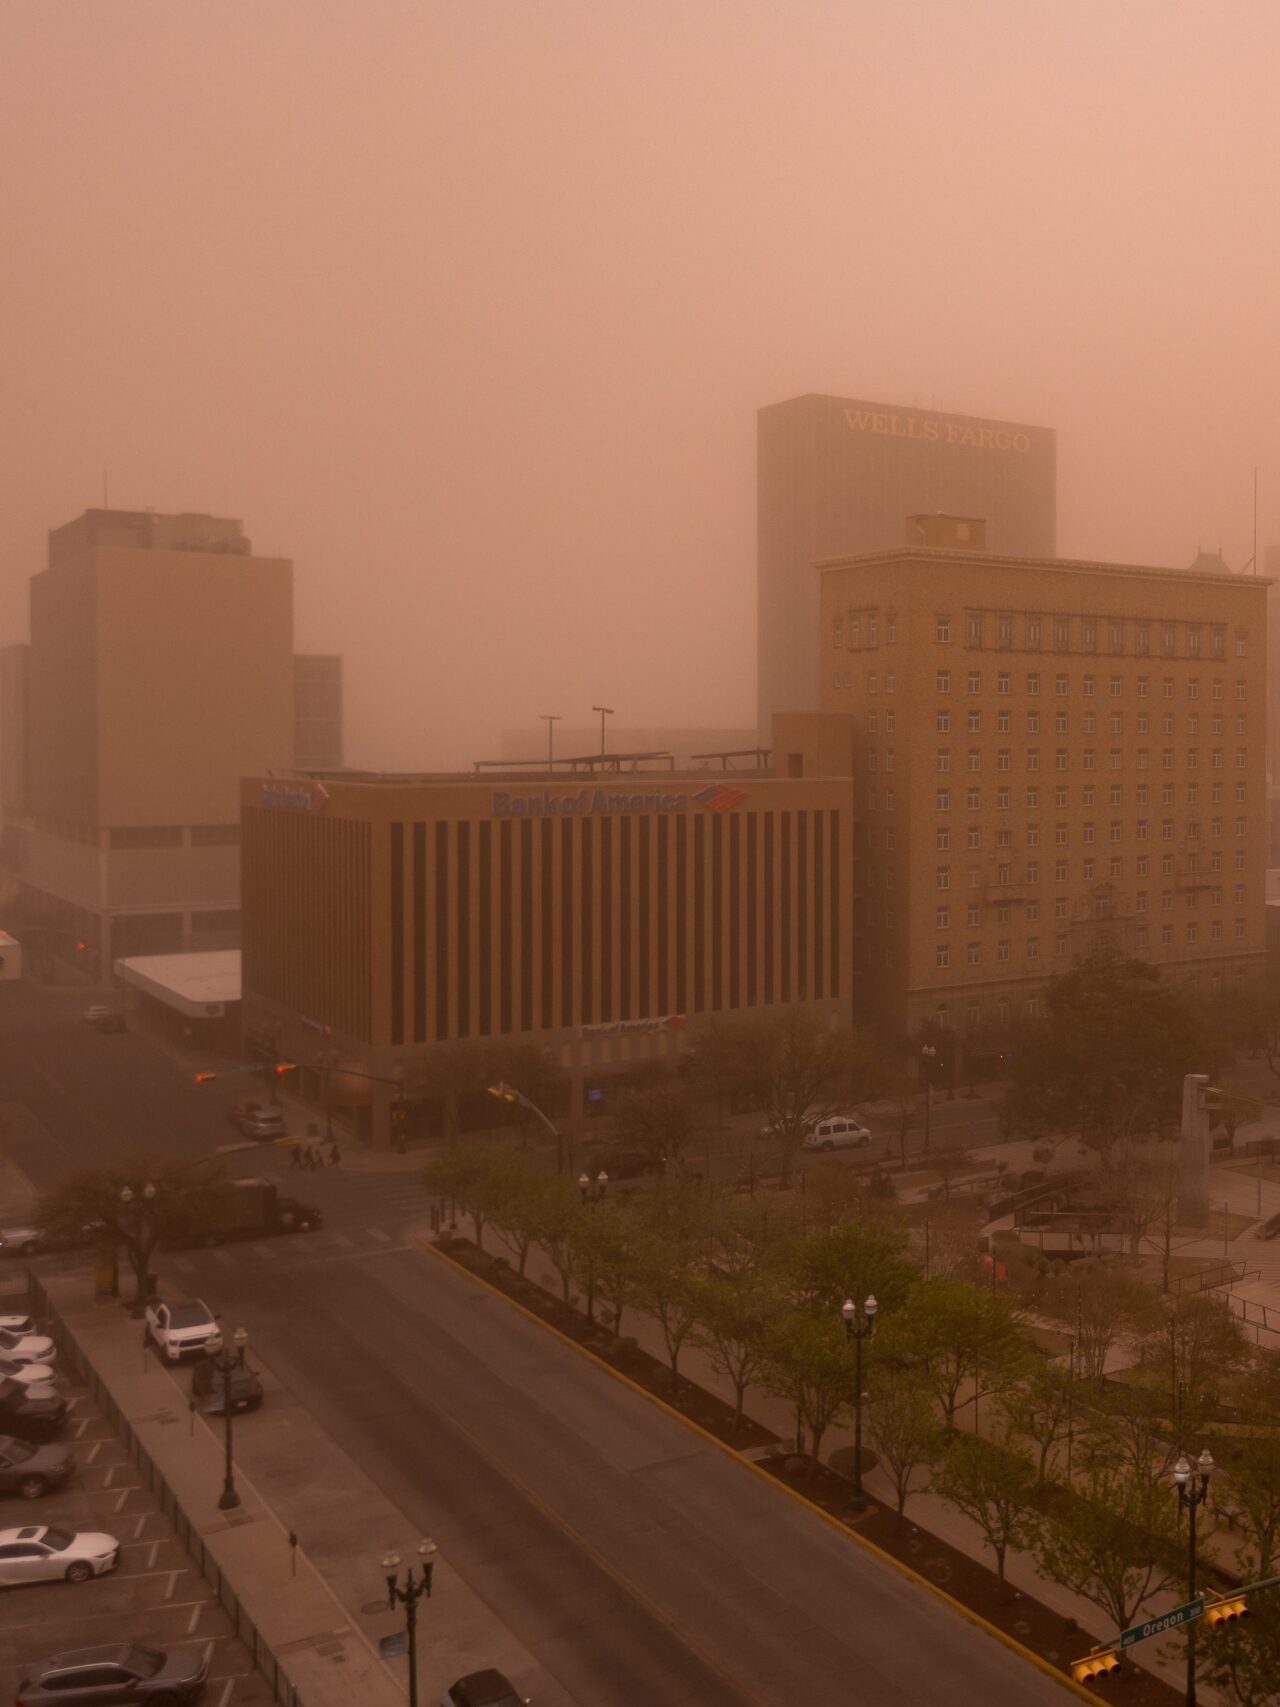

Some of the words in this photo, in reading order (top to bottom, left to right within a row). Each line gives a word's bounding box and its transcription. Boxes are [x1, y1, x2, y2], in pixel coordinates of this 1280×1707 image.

[843, 408, 939, 441] WELLS
[945, 423, 1030, 452] FARGO
[492, 790, 557, 816] Bank
[562, 789, 588, 814] of
[589, 788, 688, 815] America
[1143, 1612, 1184, 1636] Oregon
